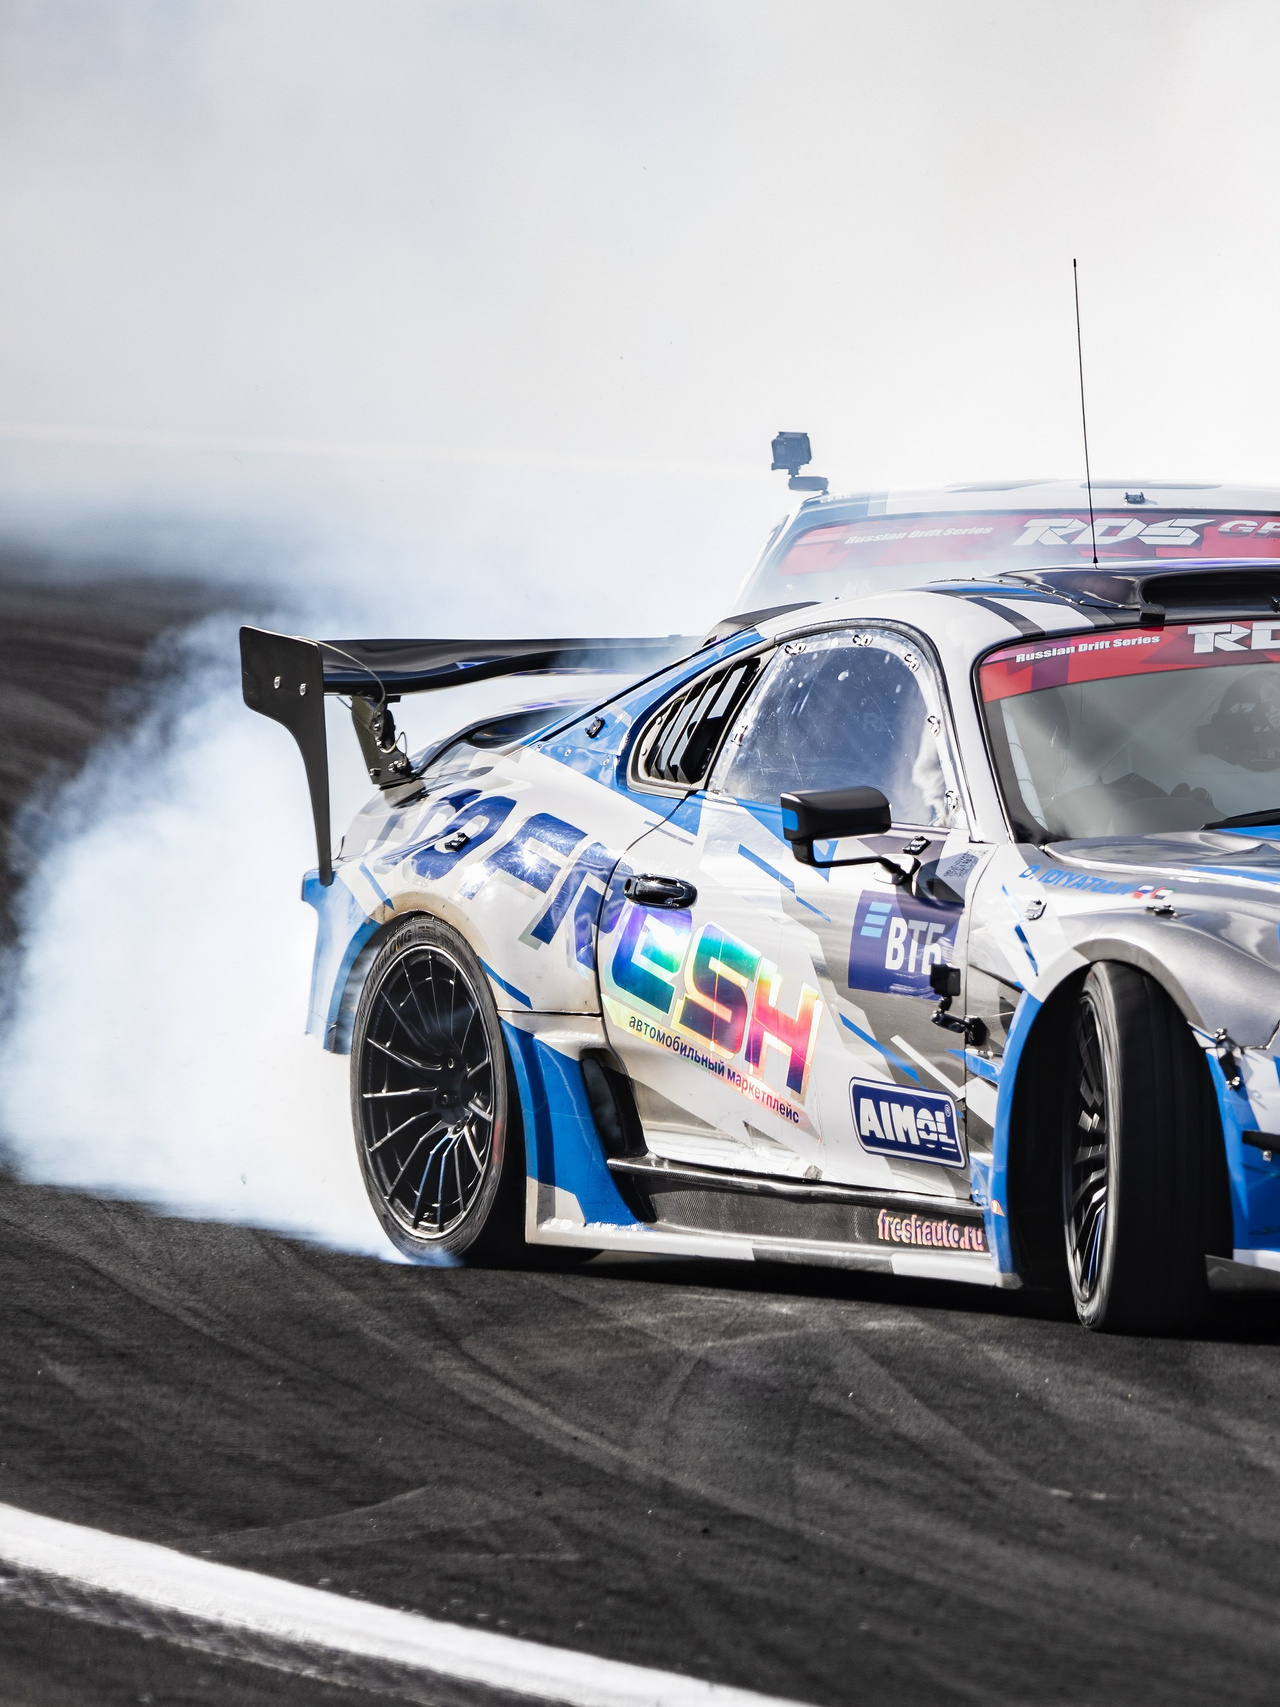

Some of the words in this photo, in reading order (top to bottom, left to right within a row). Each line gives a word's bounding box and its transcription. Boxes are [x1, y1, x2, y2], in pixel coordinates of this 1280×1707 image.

[844, 532, 904, 545] Russian
[907, 528, 943, 539] Drift
[943, 526, 994, 537] Series
[1012, 518, 1216, 546] RDS
[1015, 646, 1076, 663] Russian
[1078, 640, 1111, 653] Drift
[1112, 635, 1161, 648] Series
[629, 1015, 725, 1078] автомобильный
[727, 1067, 800, 1124] маркетплейс
[859, 1097, 957, 1152] AIMOL
[877, 1208, 985, 1252] freshauto.ru
